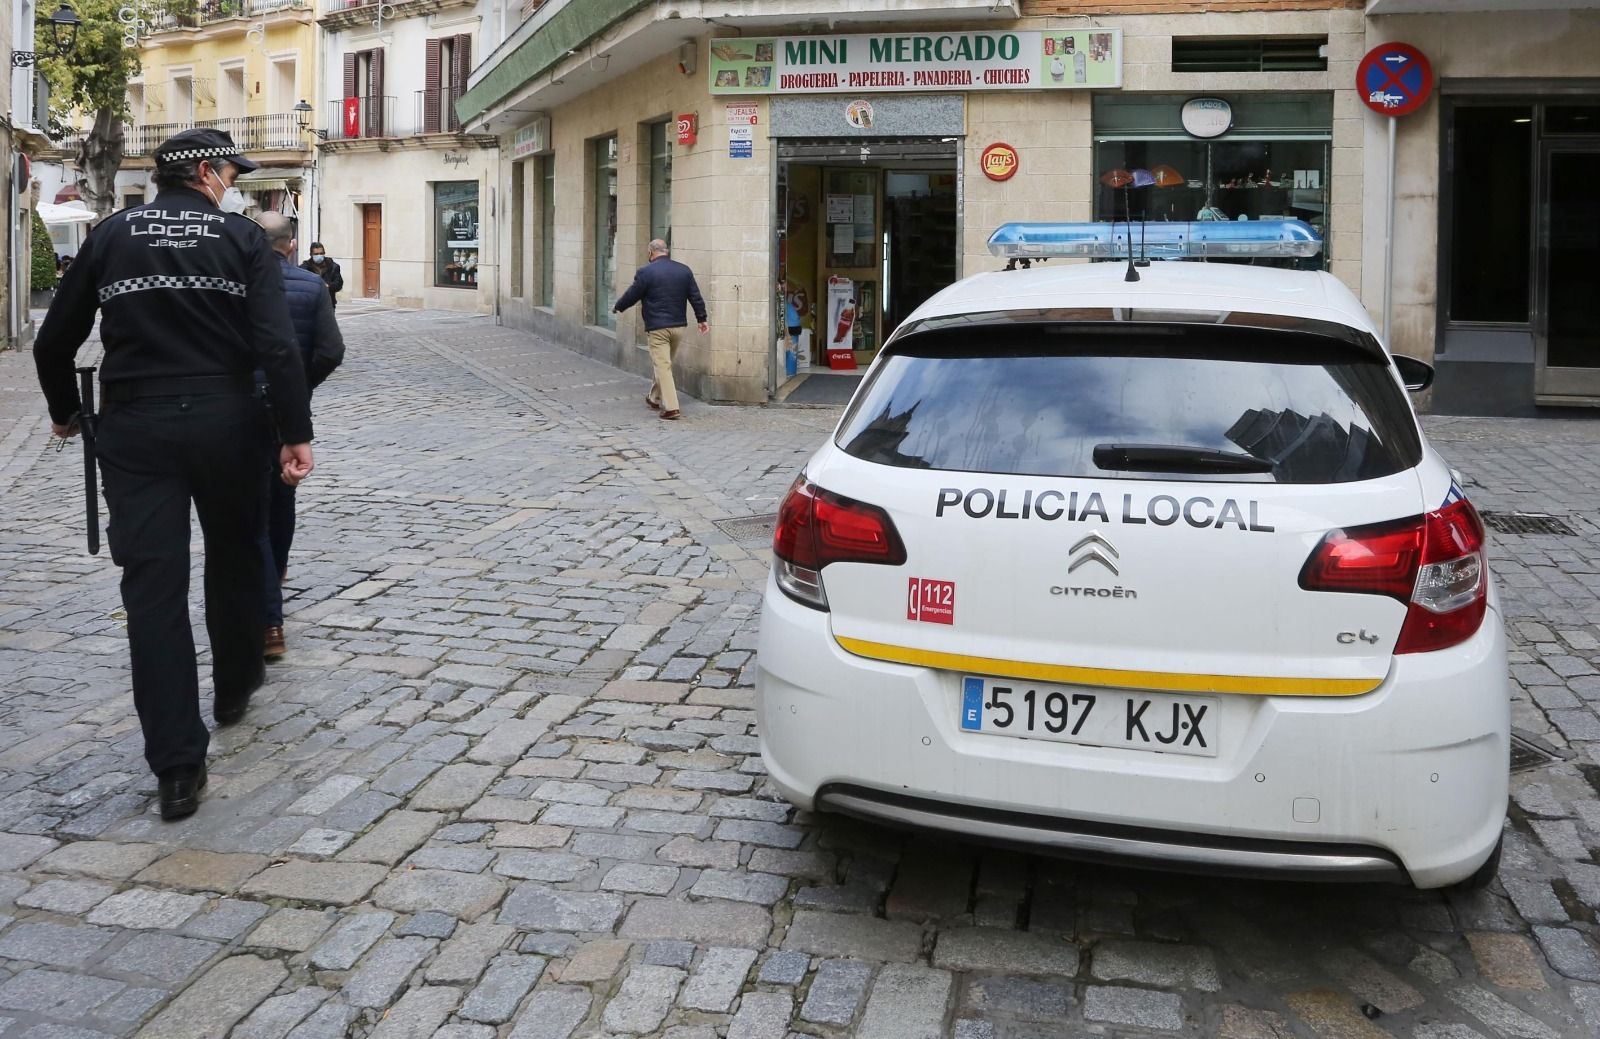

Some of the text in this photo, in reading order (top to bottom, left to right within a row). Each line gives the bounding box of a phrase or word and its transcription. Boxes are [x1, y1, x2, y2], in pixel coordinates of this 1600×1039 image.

[785, 39, 847, 65] MINI
[870, 34, 1020, 63] MERCADO
[780, 72, 838, 89] DROGUERIA
[849, 71, 905, 87] PAPELERIA
[913, 69, 972, 86] PANADERIA
[983, 68, 1030, 84] CHUCHES
[125, 209, 225, 223] POLICIA
[130, 223, 220, 238] LOCAL
[149, 239, 198, 248] JEREZ
[935, 487, 1275, 533] POLICIA LOCAL
[924, 583, 953, 605] 112
[1336, 628, 1380, 645] C4
[967, 708, 977, 721] E
[990, 686, 1208, 748] 5197 KJX
